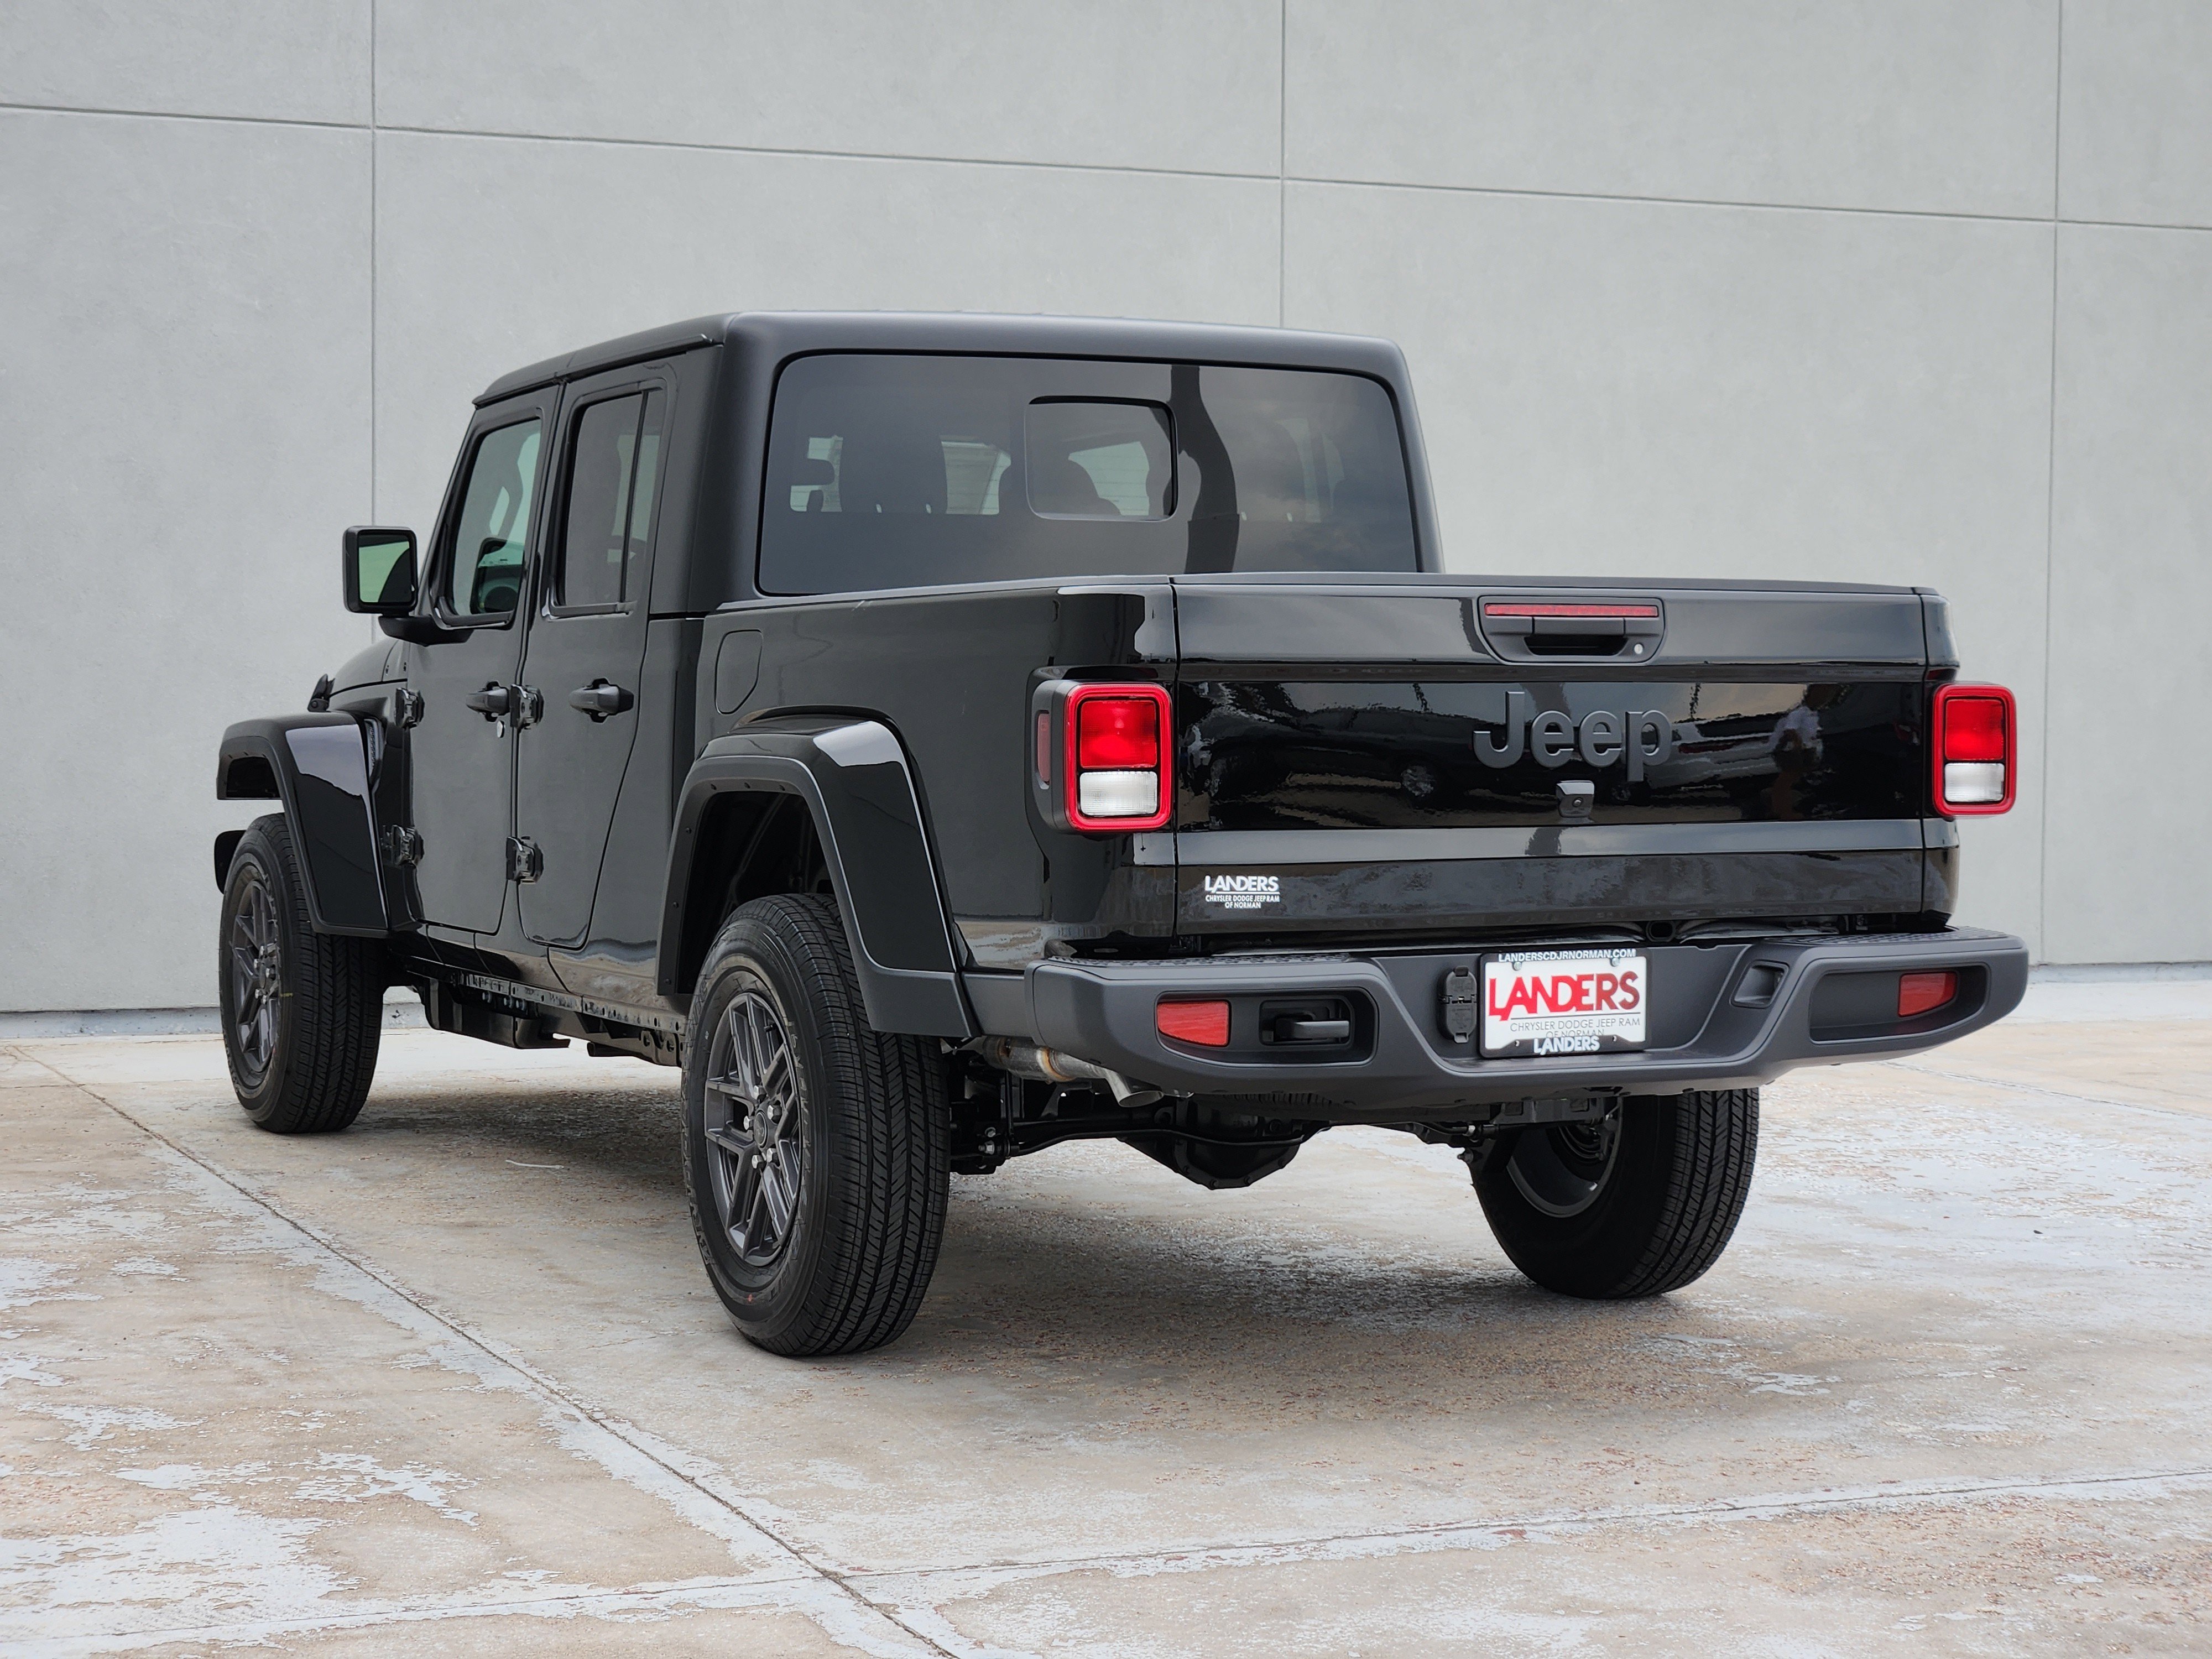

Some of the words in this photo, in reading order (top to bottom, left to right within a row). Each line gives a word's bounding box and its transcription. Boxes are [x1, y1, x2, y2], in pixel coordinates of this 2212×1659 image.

[1472, 691, 1672, 782] Jeep
[1204, 875, 1279, 893] LANDERS
[1499, 948, 1636, 963] LANDERSCDJRNORMAN.COM
[1489, 971, 1641, 1021] LANDERS
[1510, 1021, 1555, 1032] CHRYSLER
[1558, 1019, 1593, 1030] DODGE
[1596, 1018, 1615, 1028] JEEP
[1619, 1018, 1640, 1026] RAM
[1533, 1035, 1600, 1055] LANDERS
